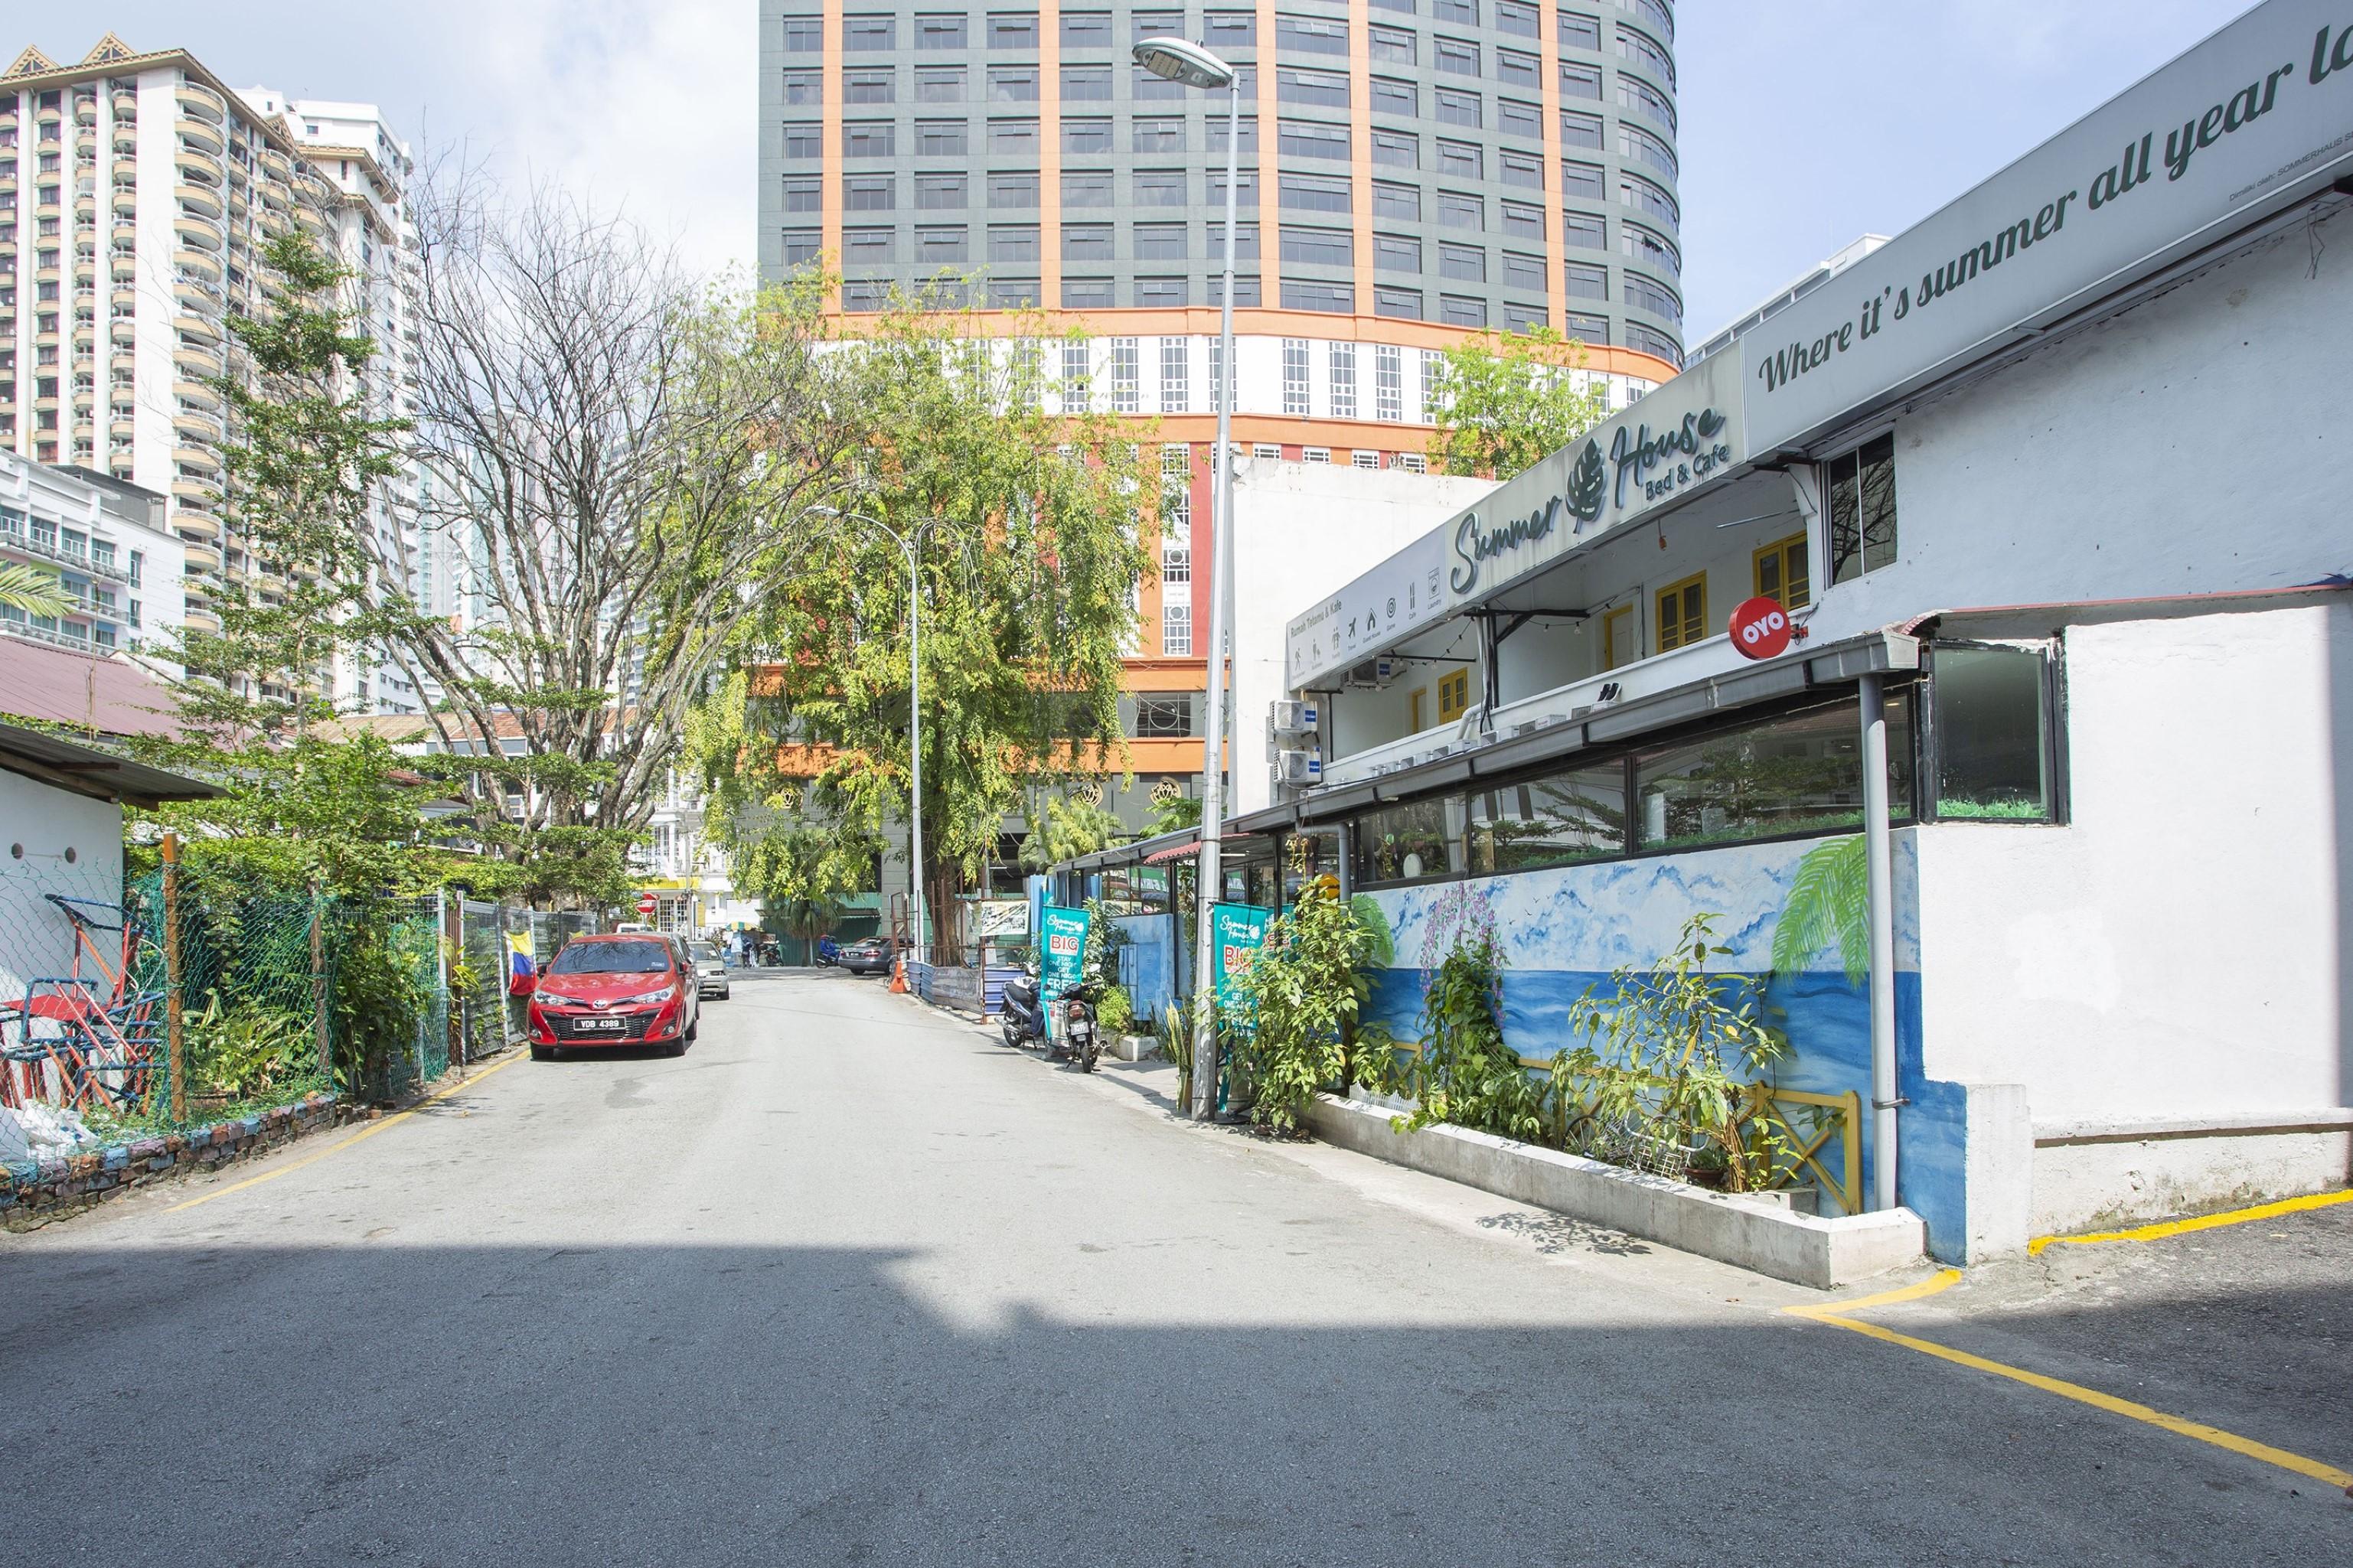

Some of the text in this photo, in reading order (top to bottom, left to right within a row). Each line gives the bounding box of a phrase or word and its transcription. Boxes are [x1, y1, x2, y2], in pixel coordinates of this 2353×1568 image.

[2277, 137, 2342, 177] SOMMERHAUS
[1758, 321, 1852, 393] Where
[1861, 286, 1910, 340] it's
[1917, 190, 2077, 308] summer
[2088, 131, 2153, 210] all
[2164, 63, 2294, 181] year
[1646, 443, 1730, 500] Bed & Cafe
[1451, 408, 1726, 595] Summer House
[1291, 600, 1342, 638] Rumah Tetamu & Kafe
[1743, 611, 1784, 644] OYO
[1051, 936, 1079, 950] BIG
[599, 1019, 619, 1028] 4389
